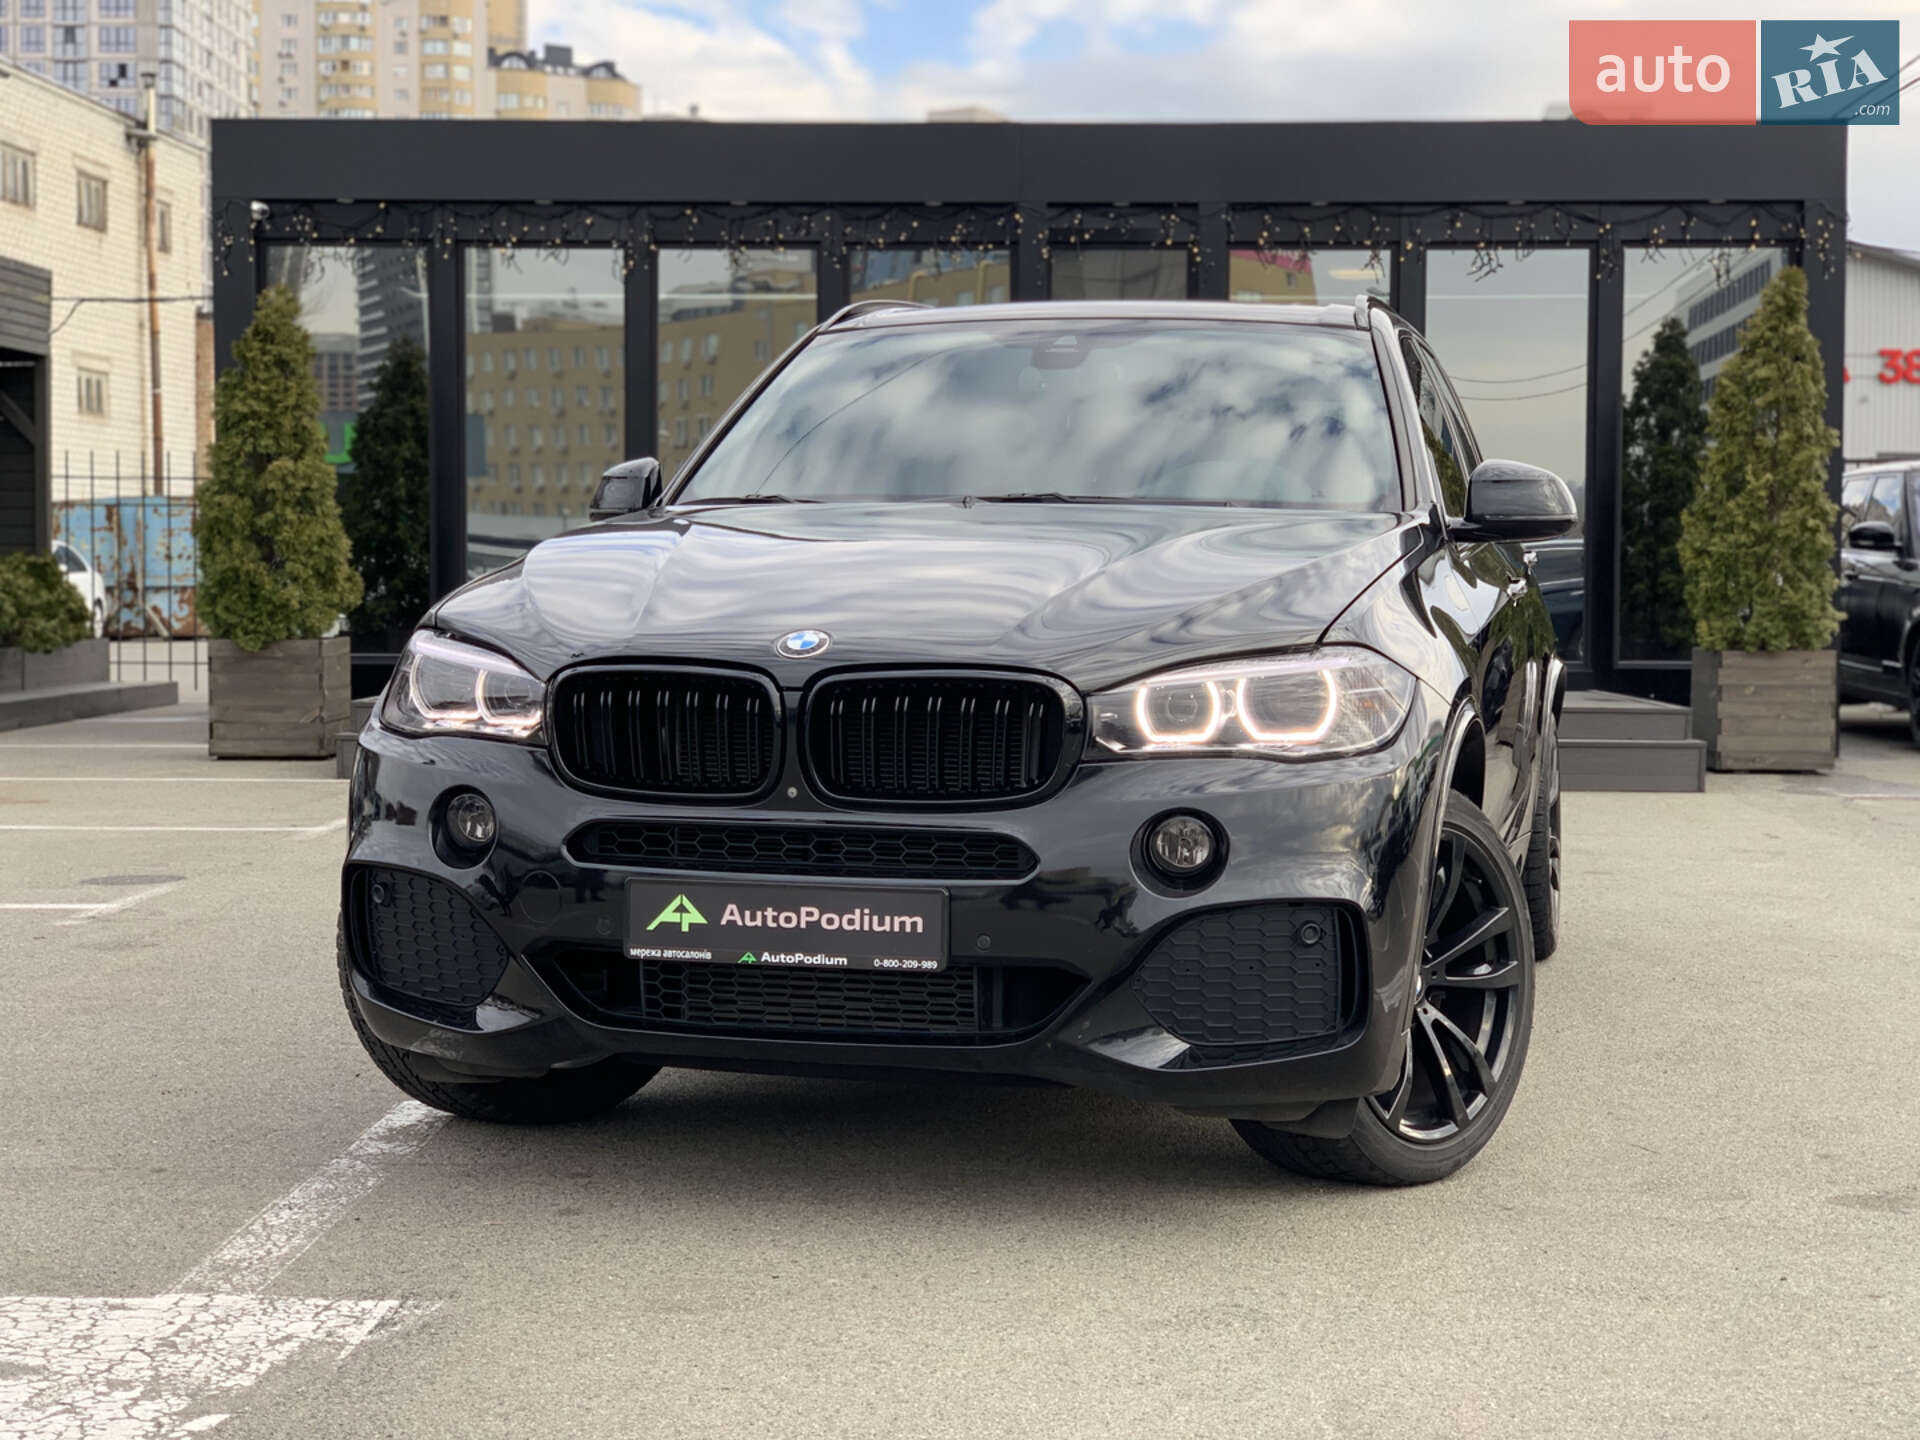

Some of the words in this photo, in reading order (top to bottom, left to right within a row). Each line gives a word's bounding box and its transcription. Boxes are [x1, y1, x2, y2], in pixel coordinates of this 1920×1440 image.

[720, 903, 924, 933] AutoPodium
[761, 951, 848, 966] AutoPodium
[873, 958, 938, 970] 0-800-209-989
